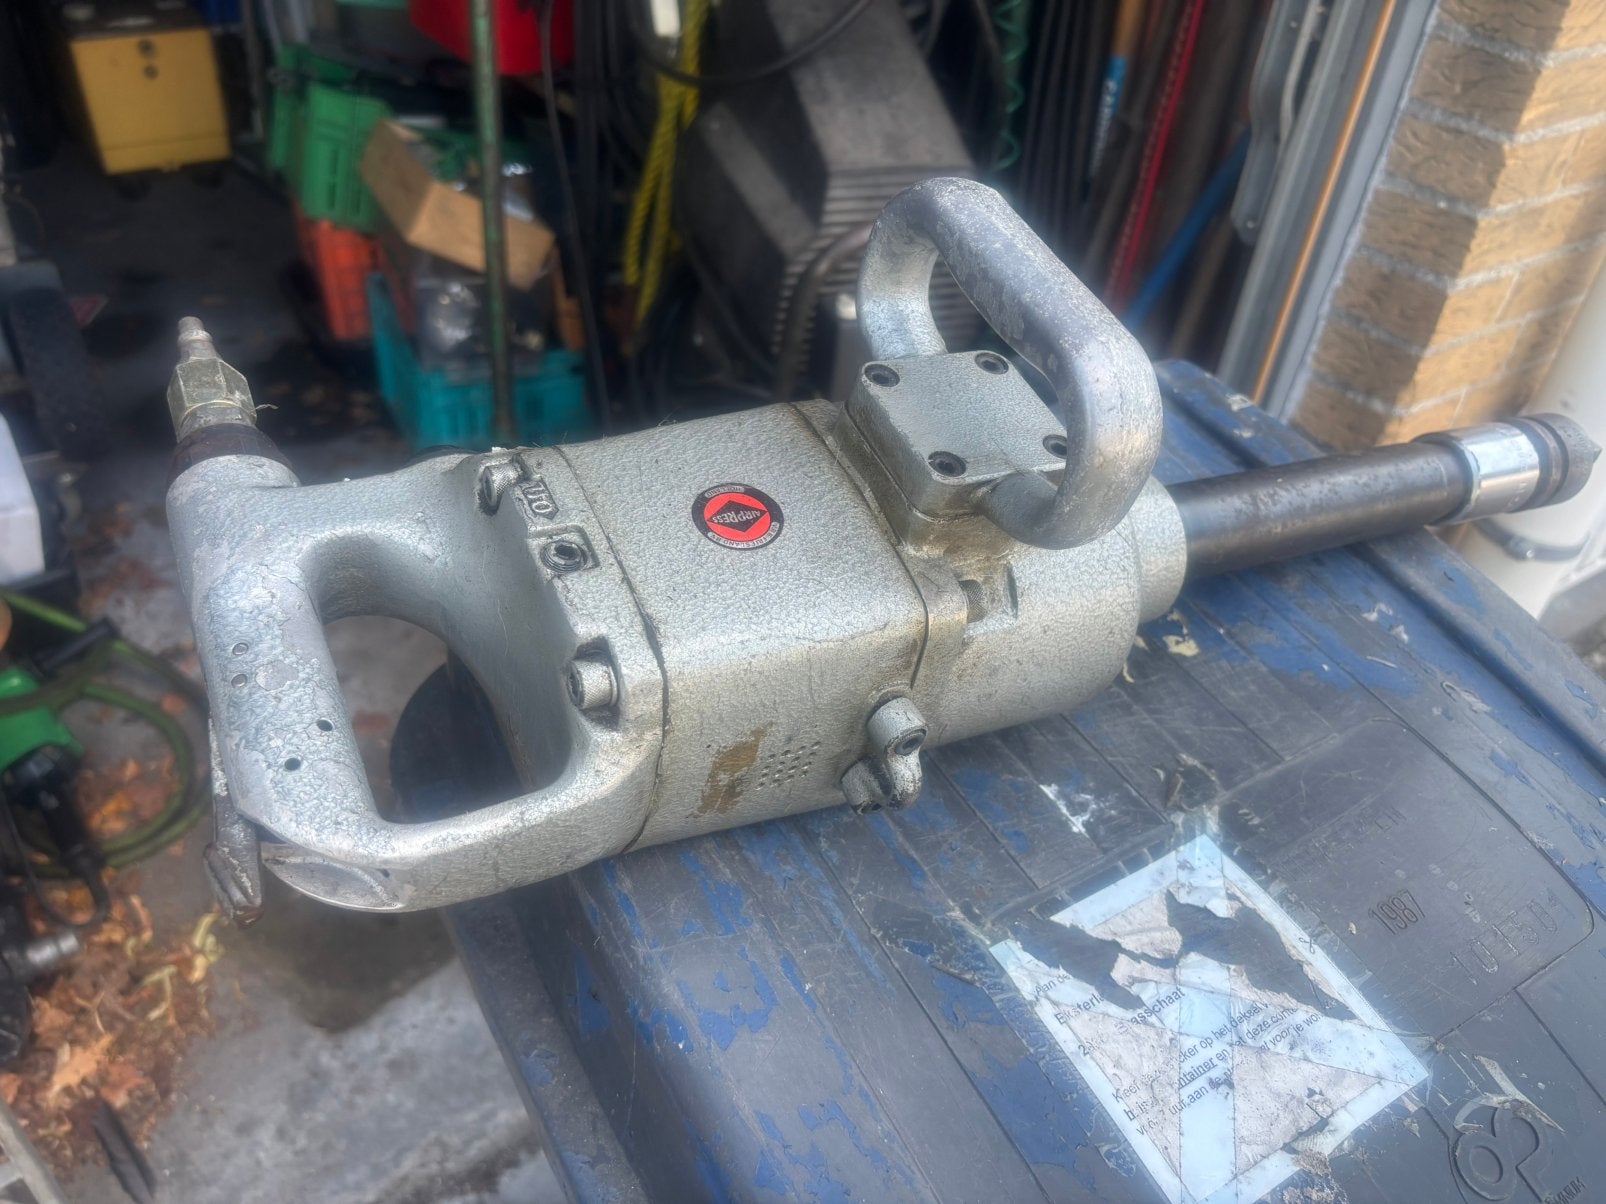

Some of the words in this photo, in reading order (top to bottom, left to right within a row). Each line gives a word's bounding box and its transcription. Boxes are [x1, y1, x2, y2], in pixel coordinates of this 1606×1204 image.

[712, 510, 761, 524] AIRPRESS
[1368, 889, 1426, 935] 1987
[1035, 980, 1056, 996] Aan
[1114, 985, 1186, 1034] Basschaat
[1199, 1036, 1214, 1049] op
[1230, 1001, 1260, 1028] deksel
[1216, 1048, 1231, 1061] en
[1245, 1020, 1271, 1040] deze
[1188, 1085, 1208, 1104] aan
[1269, 1027, 1292, 1046] voor
[1292, 1023, 1304, 1035] je
